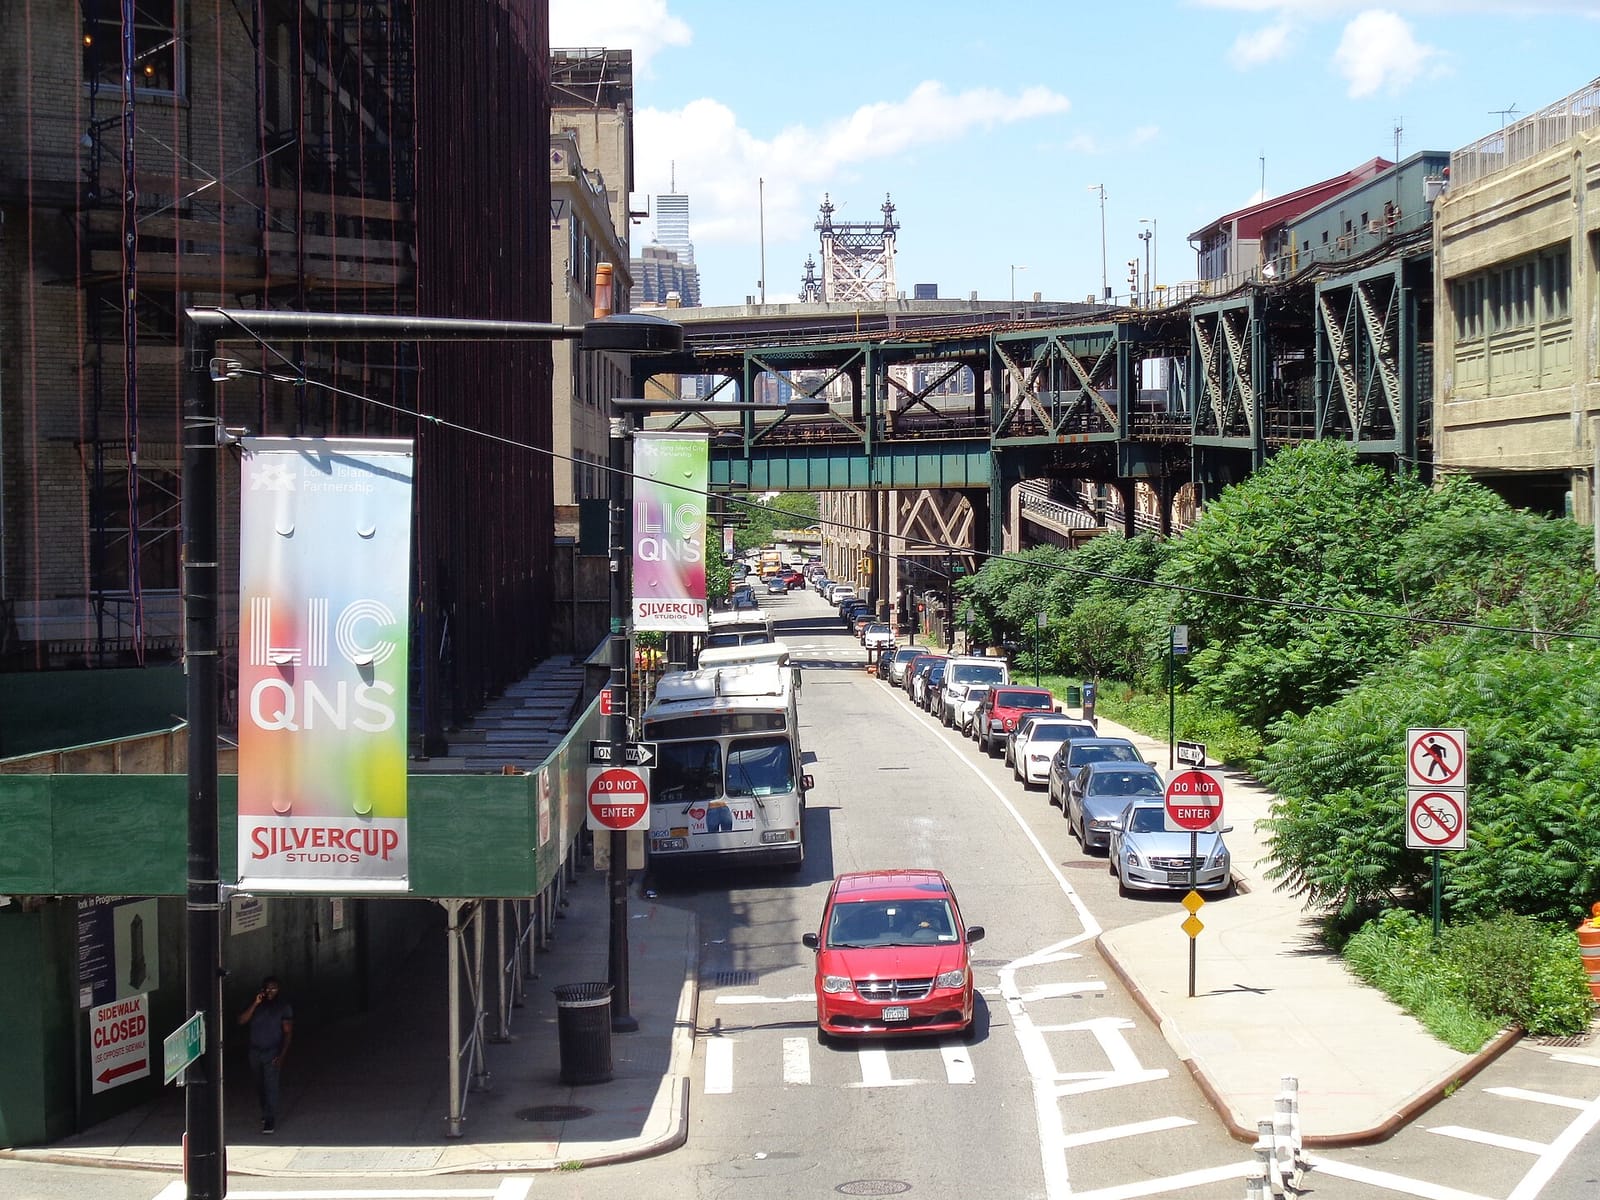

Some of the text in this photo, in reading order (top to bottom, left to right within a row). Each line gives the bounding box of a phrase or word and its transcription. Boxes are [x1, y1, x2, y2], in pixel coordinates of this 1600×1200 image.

[303, 481, 374, 495] Partnership
[637, 502, 701, 534] LIC
[637, 537, 700, 563] QNS
[639, 602, 704, 618] SILVERCUP
[250, 597, 397, 666] LIC
[250, 678, 397, 732] QNS
[598, 748, 646, 760] ON WAY
[1180, 748, 1201, 760] ONE WAY
[598, 780, 638, 791] DO NOT
[1174, 782, 1215, 792] DO NOT
[601, 807, 635, 818] ENTER
[1178, 809, 1211, 819] ENTER
[251, 826, 399, 862] SILVERCUP
[286, 853, 360, 864] STUDIOS
[98, 999, 140, 1022] SIDEWALK
[94, 1015, 146, 1049] CLOSED
